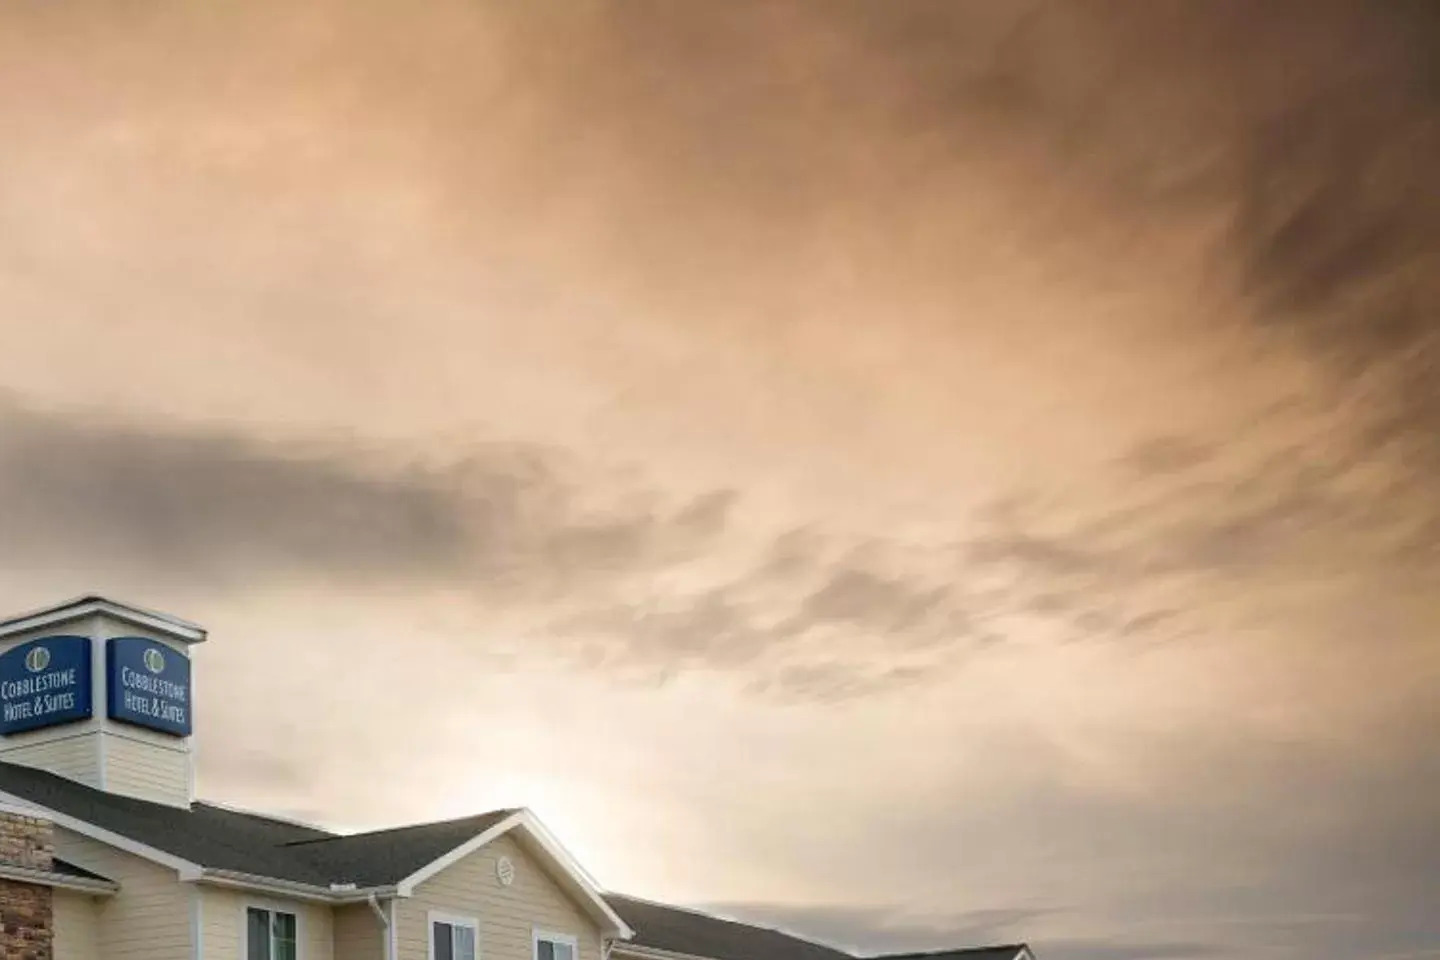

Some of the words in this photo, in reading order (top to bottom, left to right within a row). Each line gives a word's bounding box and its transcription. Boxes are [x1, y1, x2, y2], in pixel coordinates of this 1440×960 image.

[1, 668, 76, 700] COBBLESTONE
[3, 702, 33, 721] HOTEL
[34, 696, 43, 715] &
[44, 693, 74, 713] SUITES
